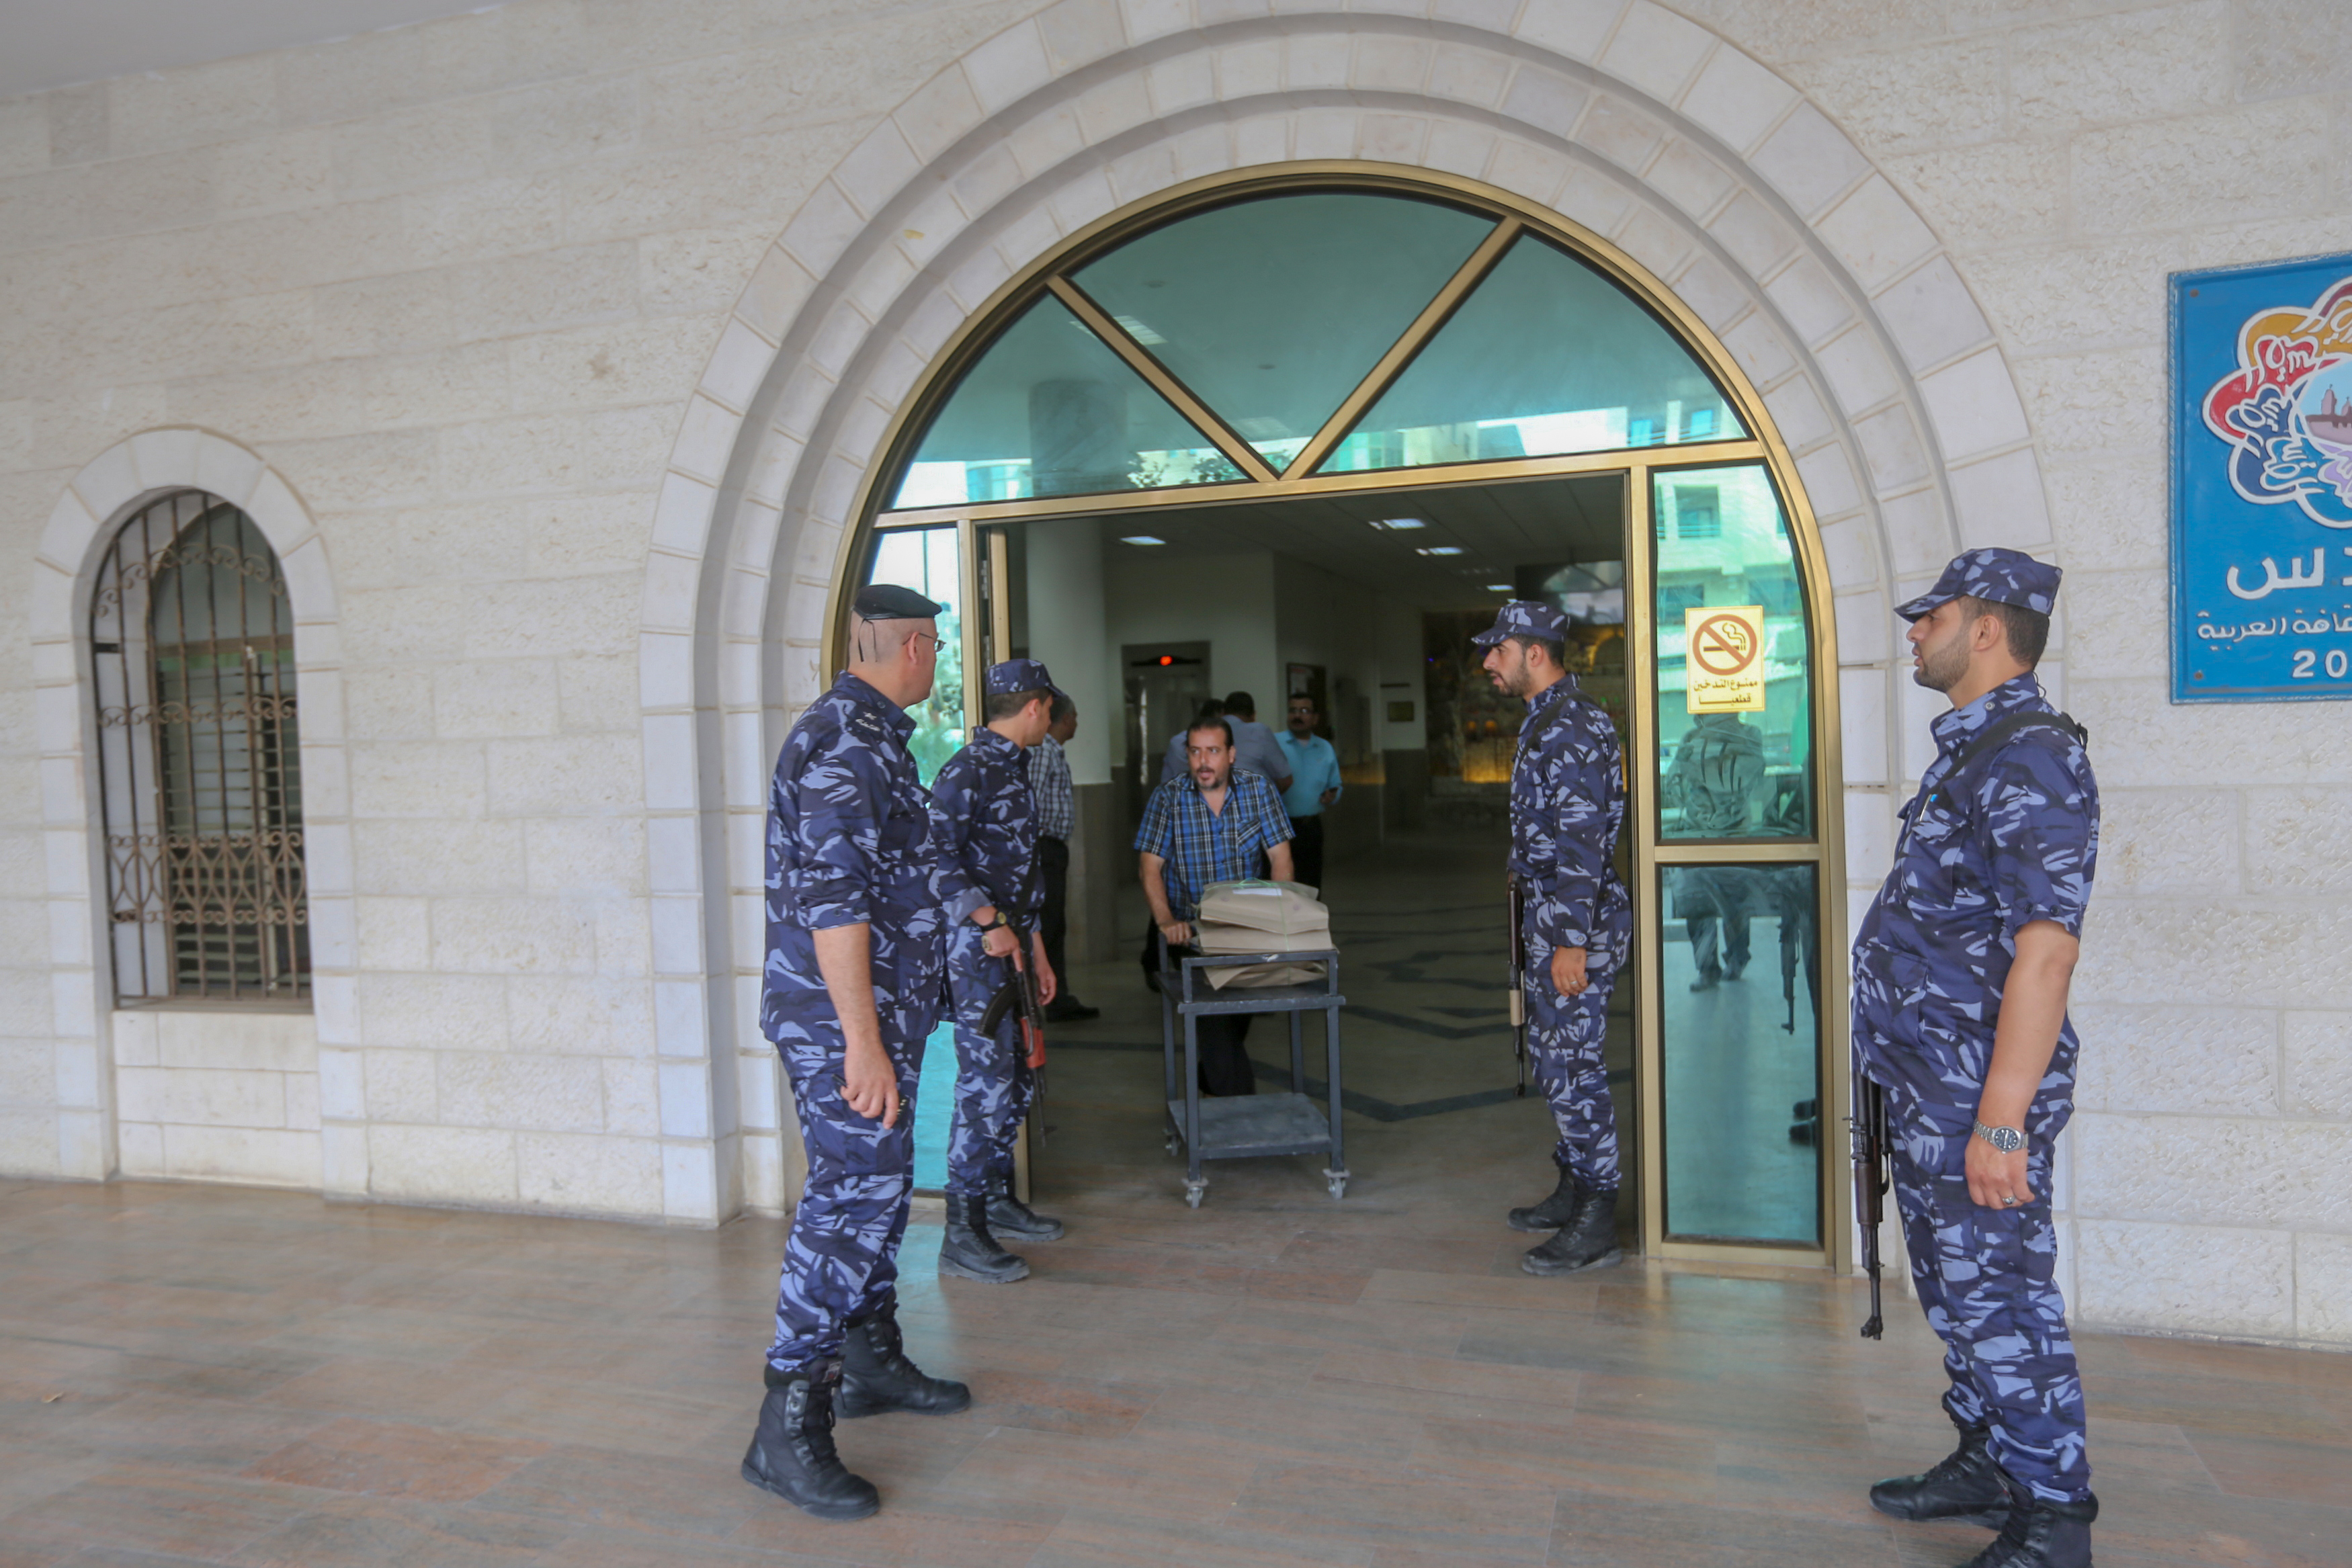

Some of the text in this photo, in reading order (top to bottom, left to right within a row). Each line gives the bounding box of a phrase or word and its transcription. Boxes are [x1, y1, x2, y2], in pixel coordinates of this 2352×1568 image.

[2197, 610, 2286, 651] العربية
[1693, 677, 1757, 693] ممنوع التدخين
